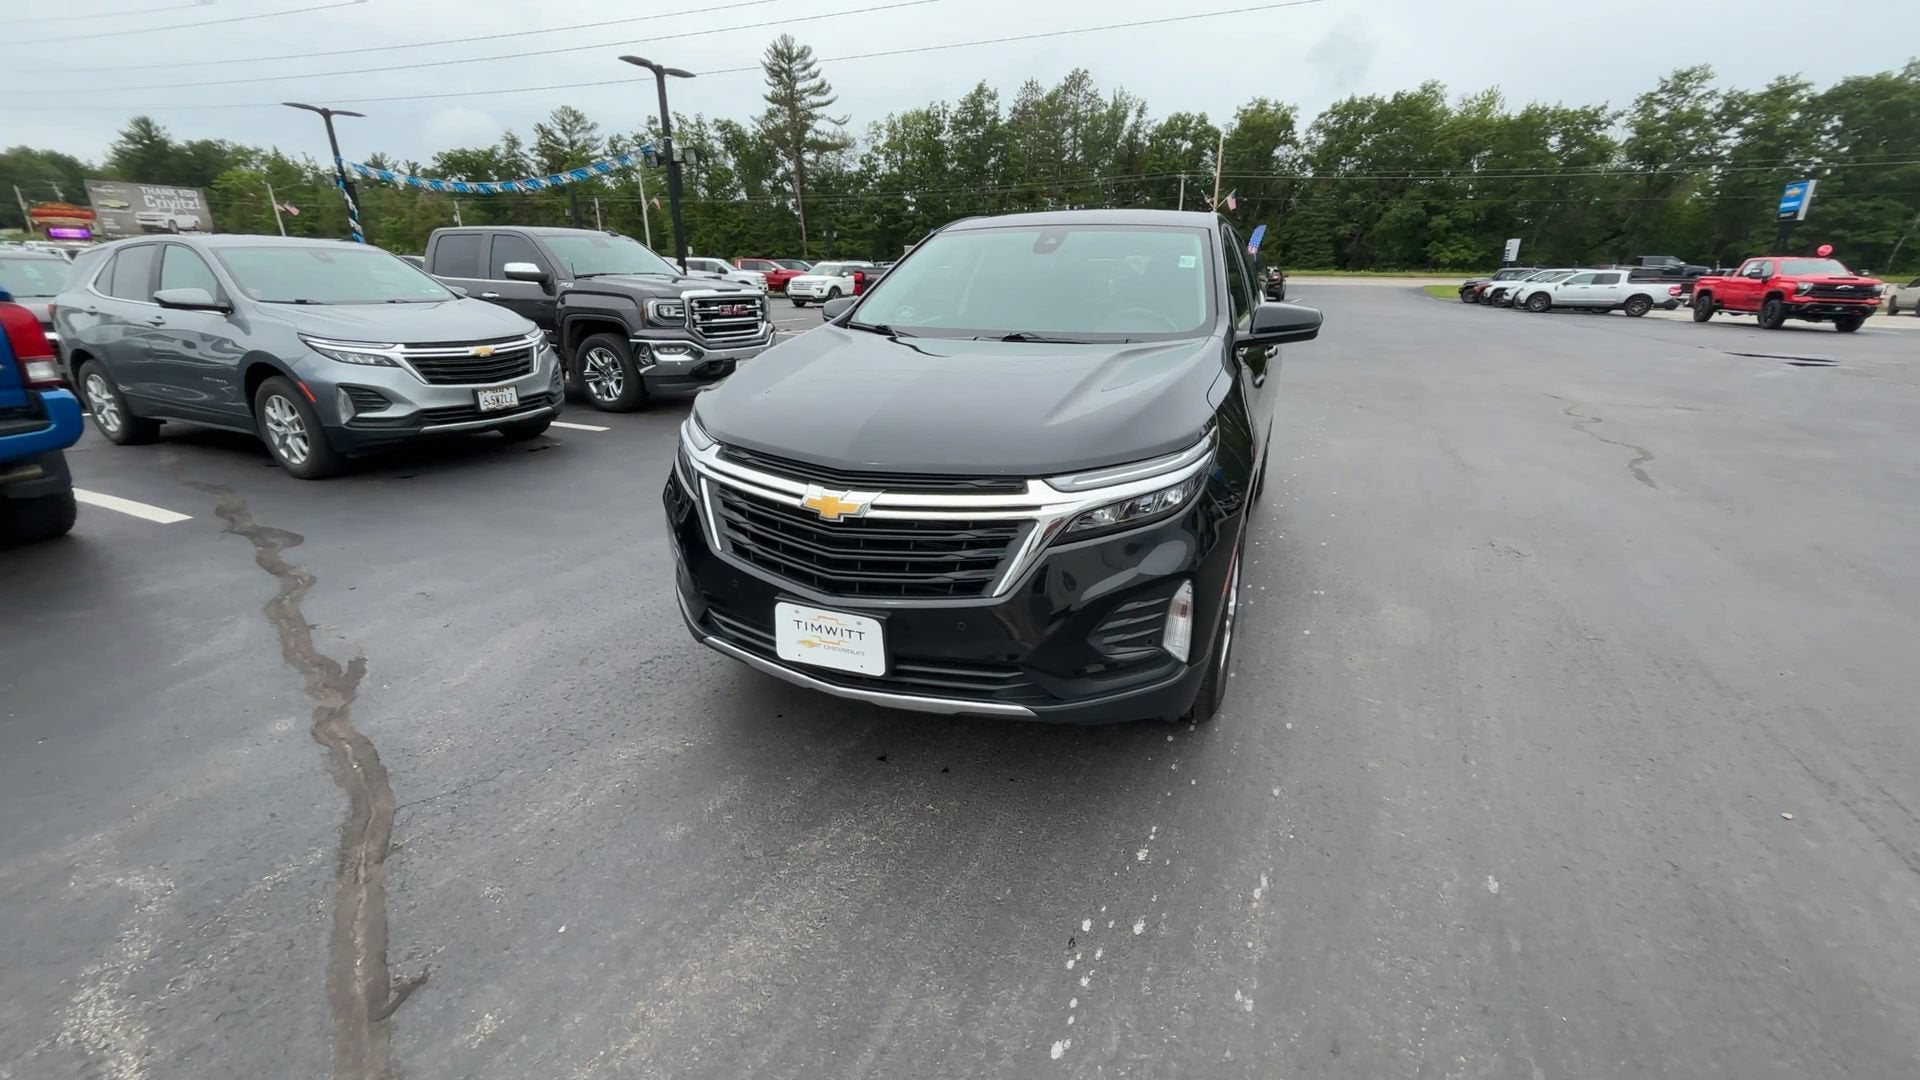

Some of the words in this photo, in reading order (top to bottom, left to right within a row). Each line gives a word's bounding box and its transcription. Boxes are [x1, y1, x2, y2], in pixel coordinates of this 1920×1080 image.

[139, 186, 176, 196] THANK
[177, 189, 198, 198] YOU
[144, 196, 201, 209] Crivitz!
[718, 304, 748, 316] GMC
[793, 619, 865, 640] TIMWITT
[824, 644, 865, 656] CHEVROLET
